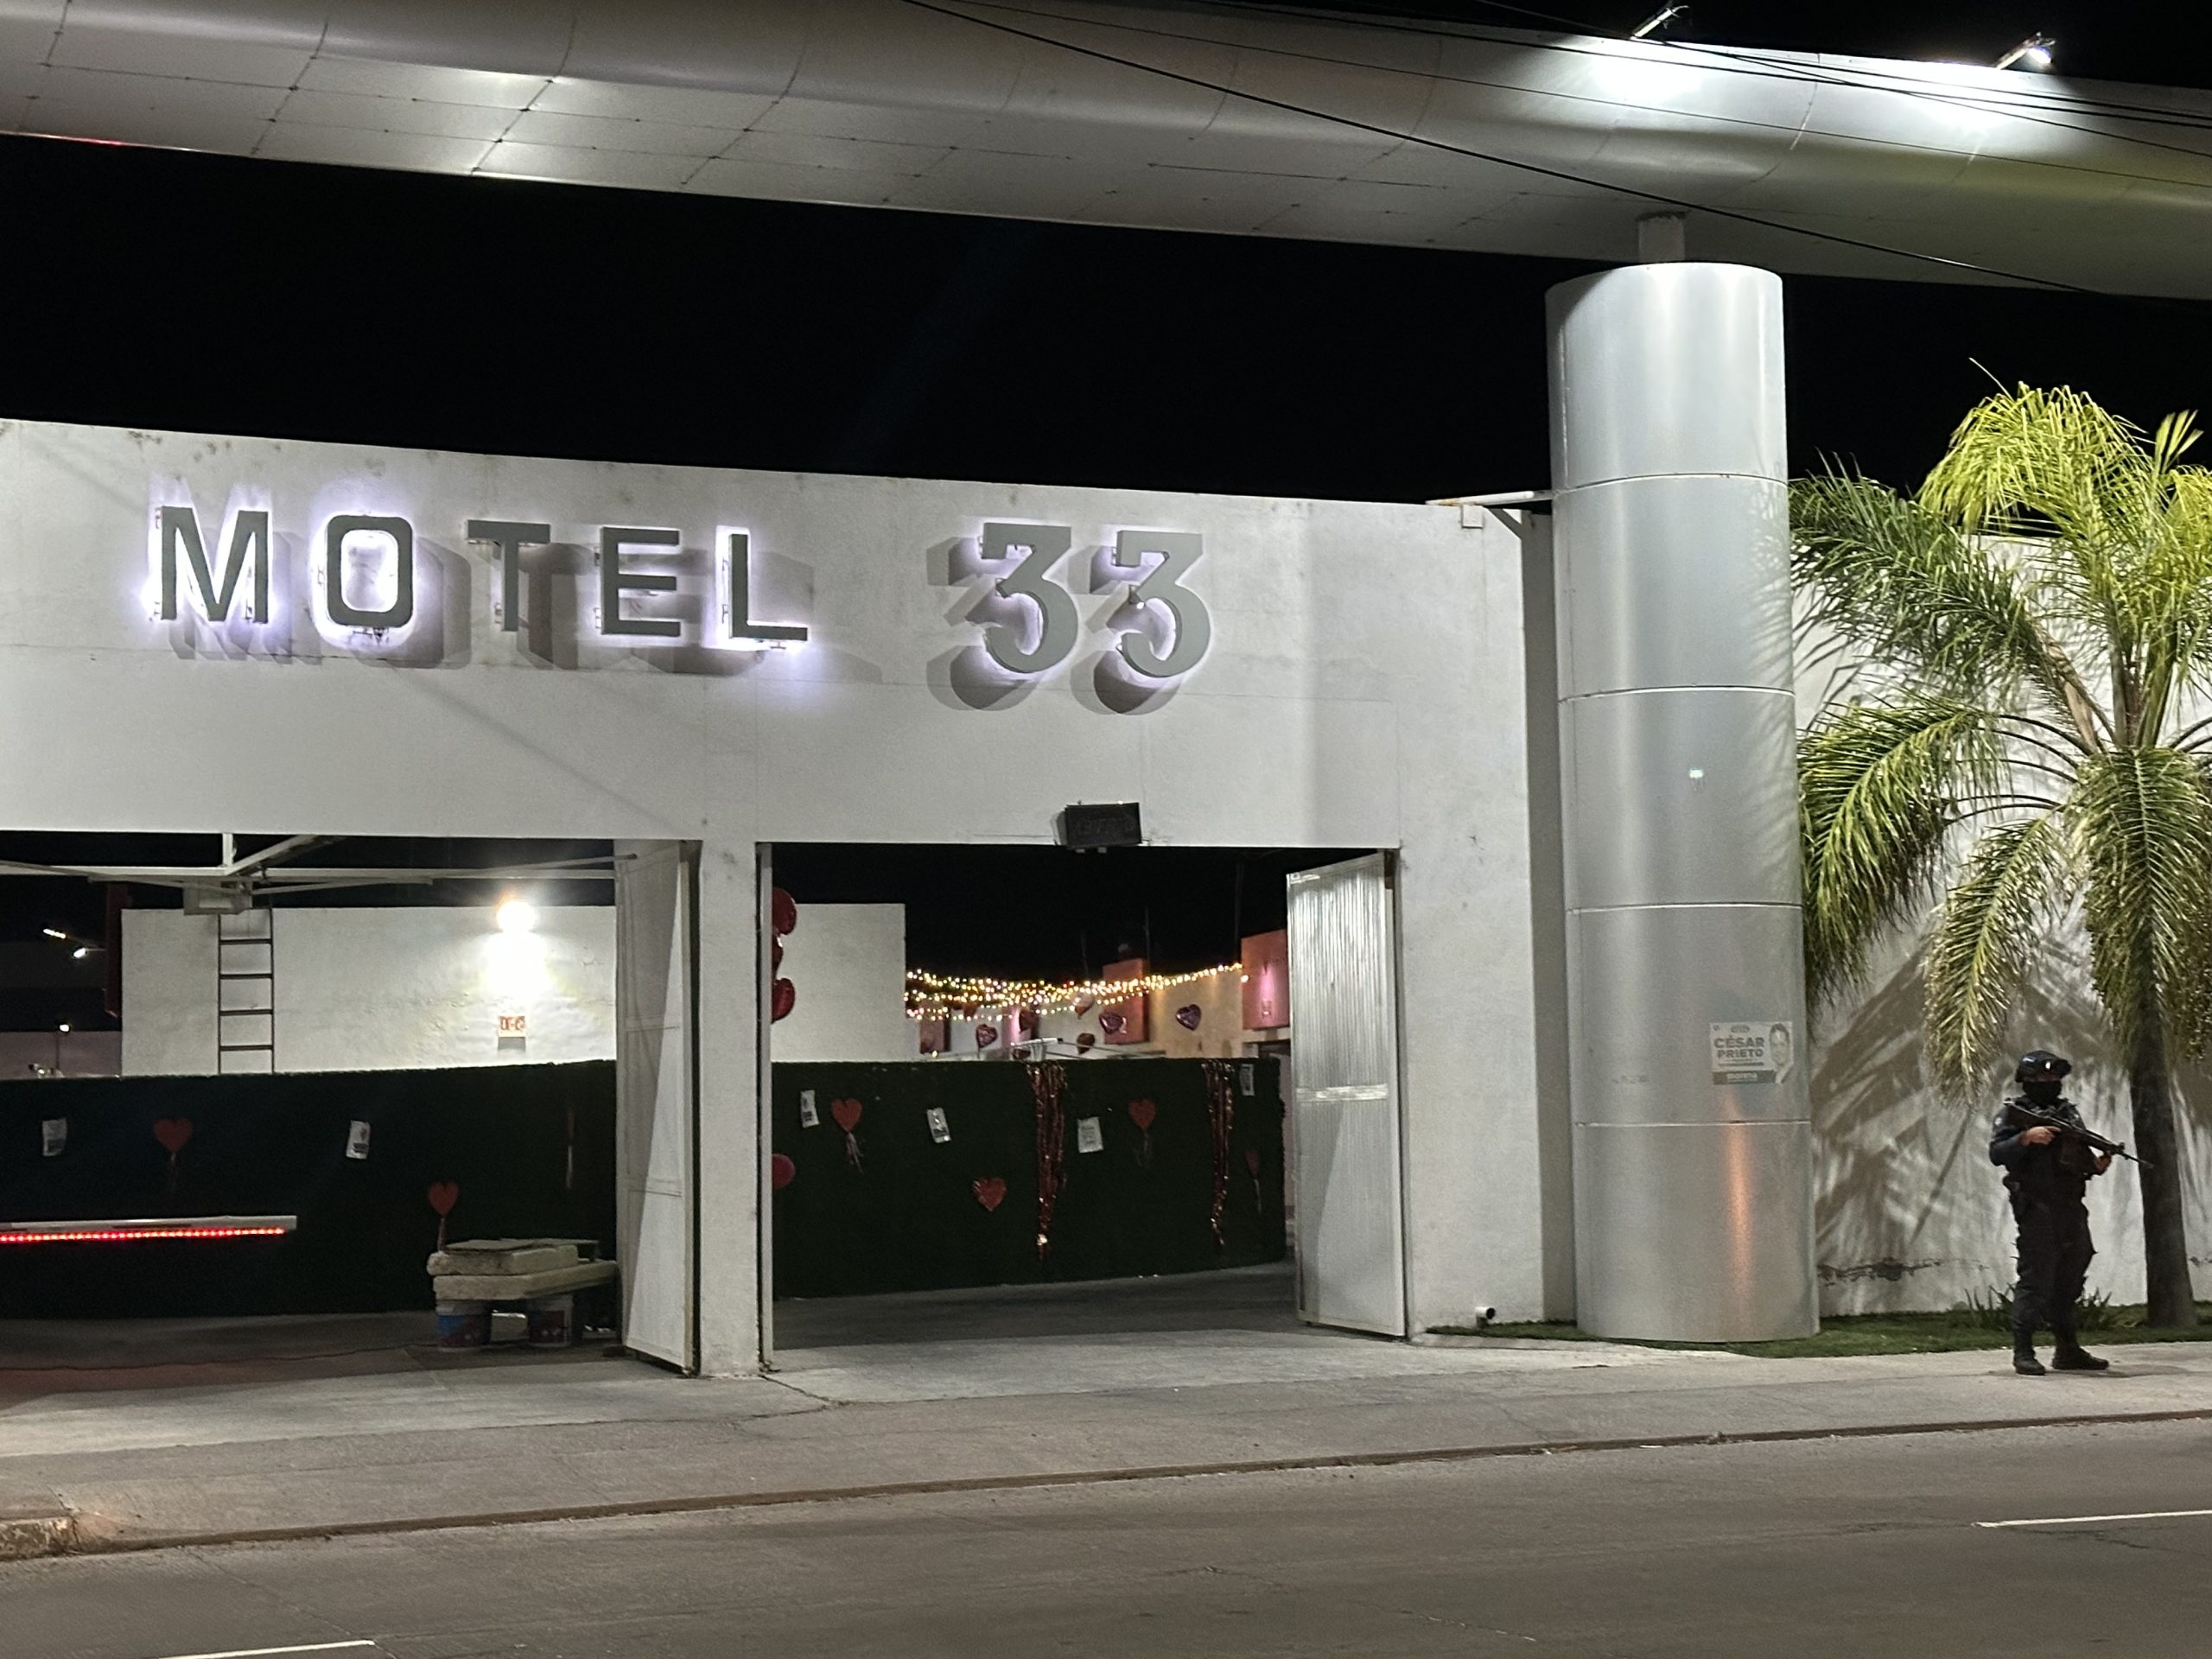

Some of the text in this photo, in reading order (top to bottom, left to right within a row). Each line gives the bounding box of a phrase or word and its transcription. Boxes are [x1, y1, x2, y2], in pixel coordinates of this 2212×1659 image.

[160, 505, 1211, 677] MOTEL 33
[1713, 1034, 1764, 1048] CÉSAR
[1717, 1049, 1764, 1058] PRIETO
